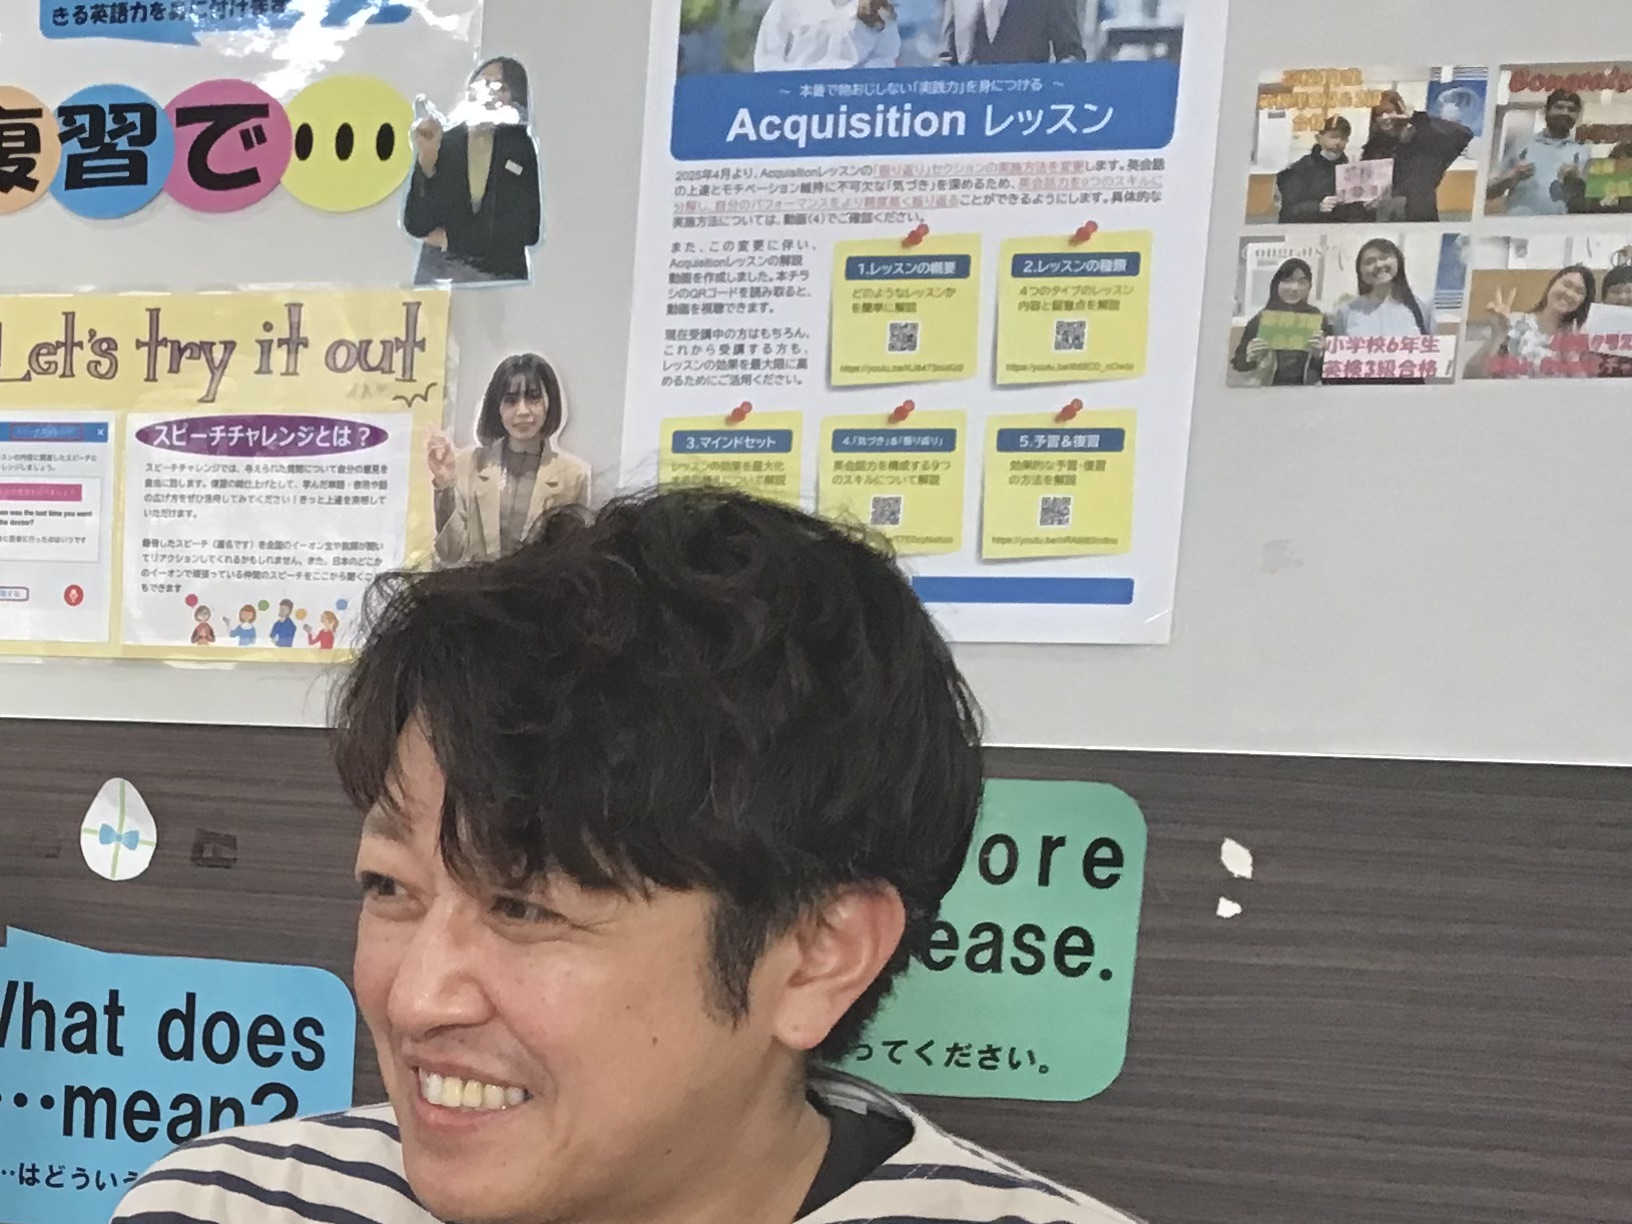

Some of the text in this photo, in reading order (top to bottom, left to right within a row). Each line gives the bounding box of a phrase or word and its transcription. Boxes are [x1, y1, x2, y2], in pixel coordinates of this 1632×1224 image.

[726, 102, 1114, 148] Acquisition レッスン
[135, 307, 236, 403] try
[255, 302, 308, 376] it
[325, 301, 426, 383] out
[153, 422, 372, 449] スピーチチャレンジとは？
[686, 436, 777, 449] 3.マインドセット
[978, 832, 1124, 889] ore
[921, 920, 1113, 981] ease.
[157, 992, 325, 1071] does
